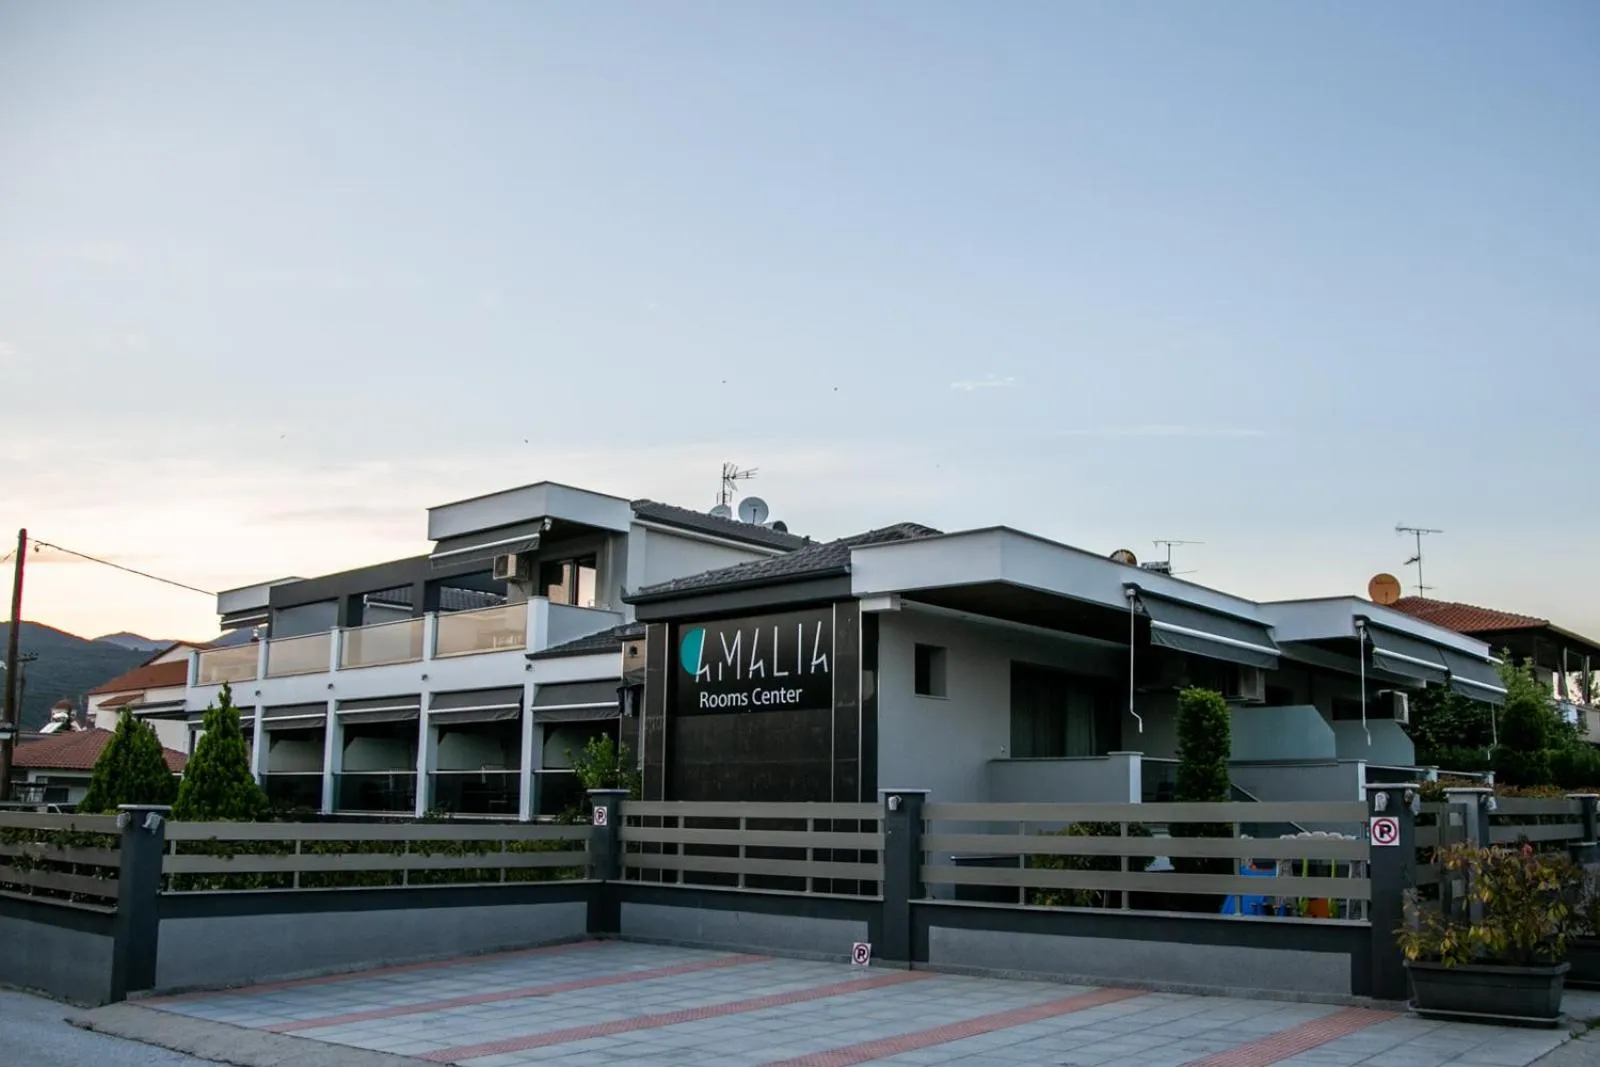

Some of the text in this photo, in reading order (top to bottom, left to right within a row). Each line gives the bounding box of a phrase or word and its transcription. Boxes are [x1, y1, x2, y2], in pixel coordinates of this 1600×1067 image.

[695, 621, 829, 683] AMALIA
[700, 688, 803, 708] Rooms Center
